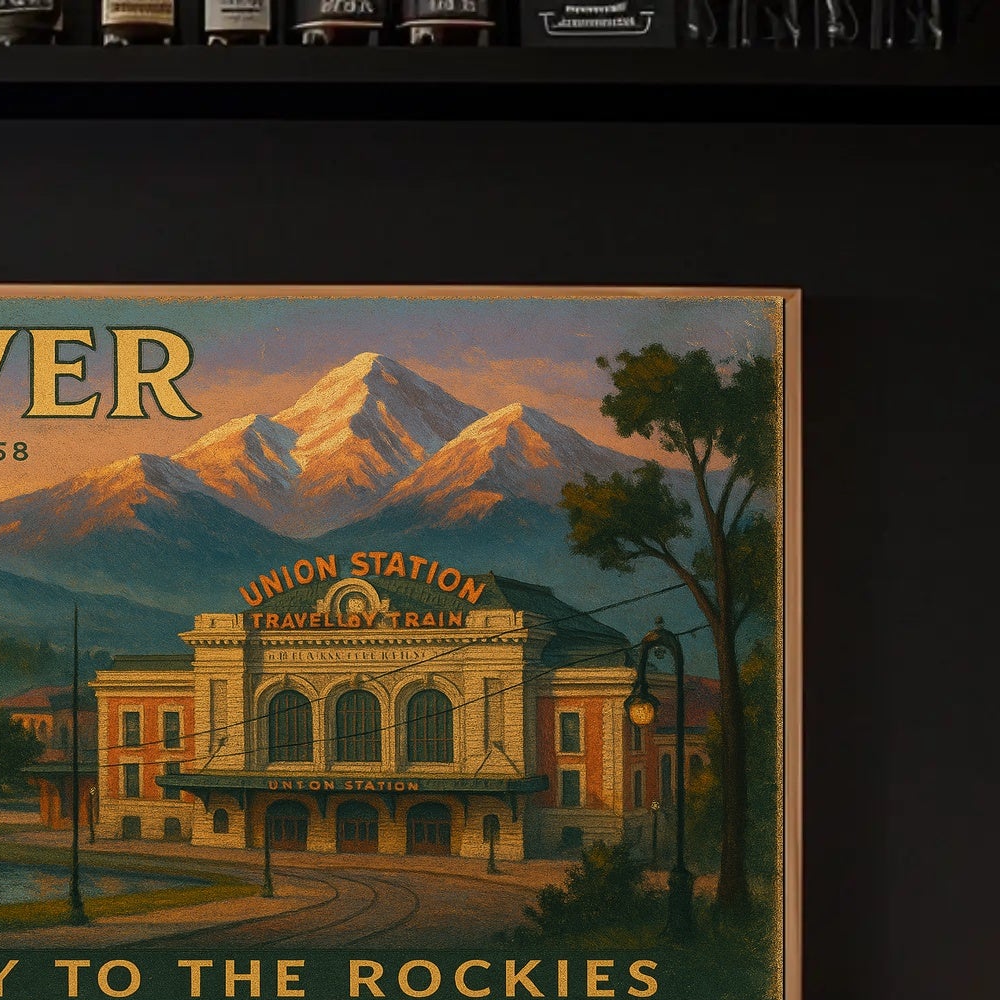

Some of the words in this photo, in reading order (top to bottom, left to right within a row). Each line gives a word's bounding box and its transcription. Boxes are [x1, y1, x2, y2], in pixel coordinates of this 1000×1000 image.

[239, 554, 337, 606] UNION
[350, 551, 486, 604] STATION
[385, 611, 463, 628] TRAIN
[343, 780, 419, 791] STATION
[55, 959, 143, 998] TO
[178, 959, 307, 998] THE
[347, 959, 660, 998] ROCKIES
